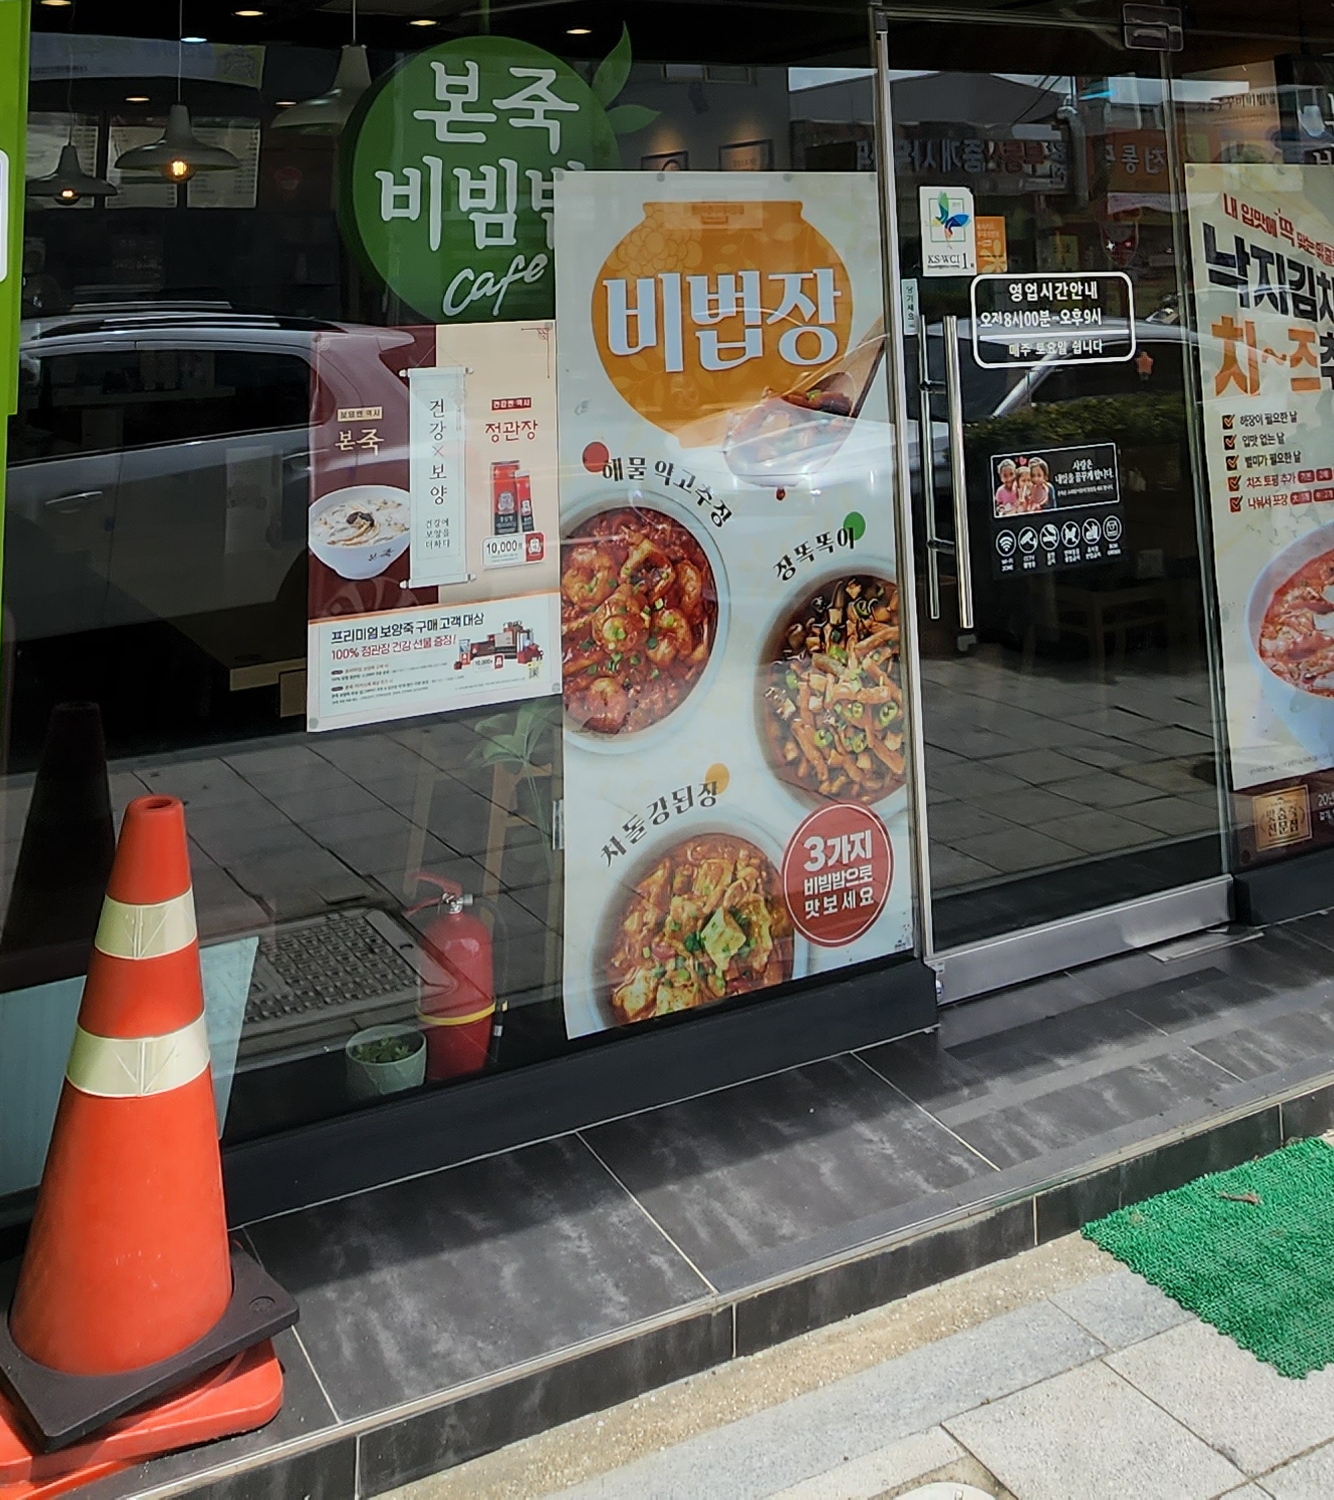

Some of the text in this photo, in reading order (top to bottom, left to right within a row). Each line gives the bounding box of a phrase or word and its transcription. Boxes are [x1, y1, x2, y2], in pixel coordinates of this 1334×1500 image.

[413, 59, 580, 156] 본죽
[1223, 192, 1238, 220] 내
[1241, 203, 1278, 238] 입맛에
[1279, 214, 1296, 247] 딱
[1008, 280, 1098, 302] 영업시간안내
[601, 266, 843, 373] 비법장
[1071, 338, 1103, 355] 쉽니다
[334, 428, 385, 457] 본죽
[485, 419, 539, 443] 정관장
[602, 456, 646, 482] 해물
[773, 526, 856, 582] 장똑똑이
[331, 612, 484, 644] 프리미엄 보양죽 구매 고객 대상
[331, 647, 360, 660] 100%
[361, 643, 390, 658] 정관장
[392, 641, 412, 653] 건강
[414, 638, 432, 650] 선물
[600, 780, 719, 868] 차돌강된장
[803, 829, 872, 872] 3가지
[803, 864, 873, 896] 비빔밥으로
